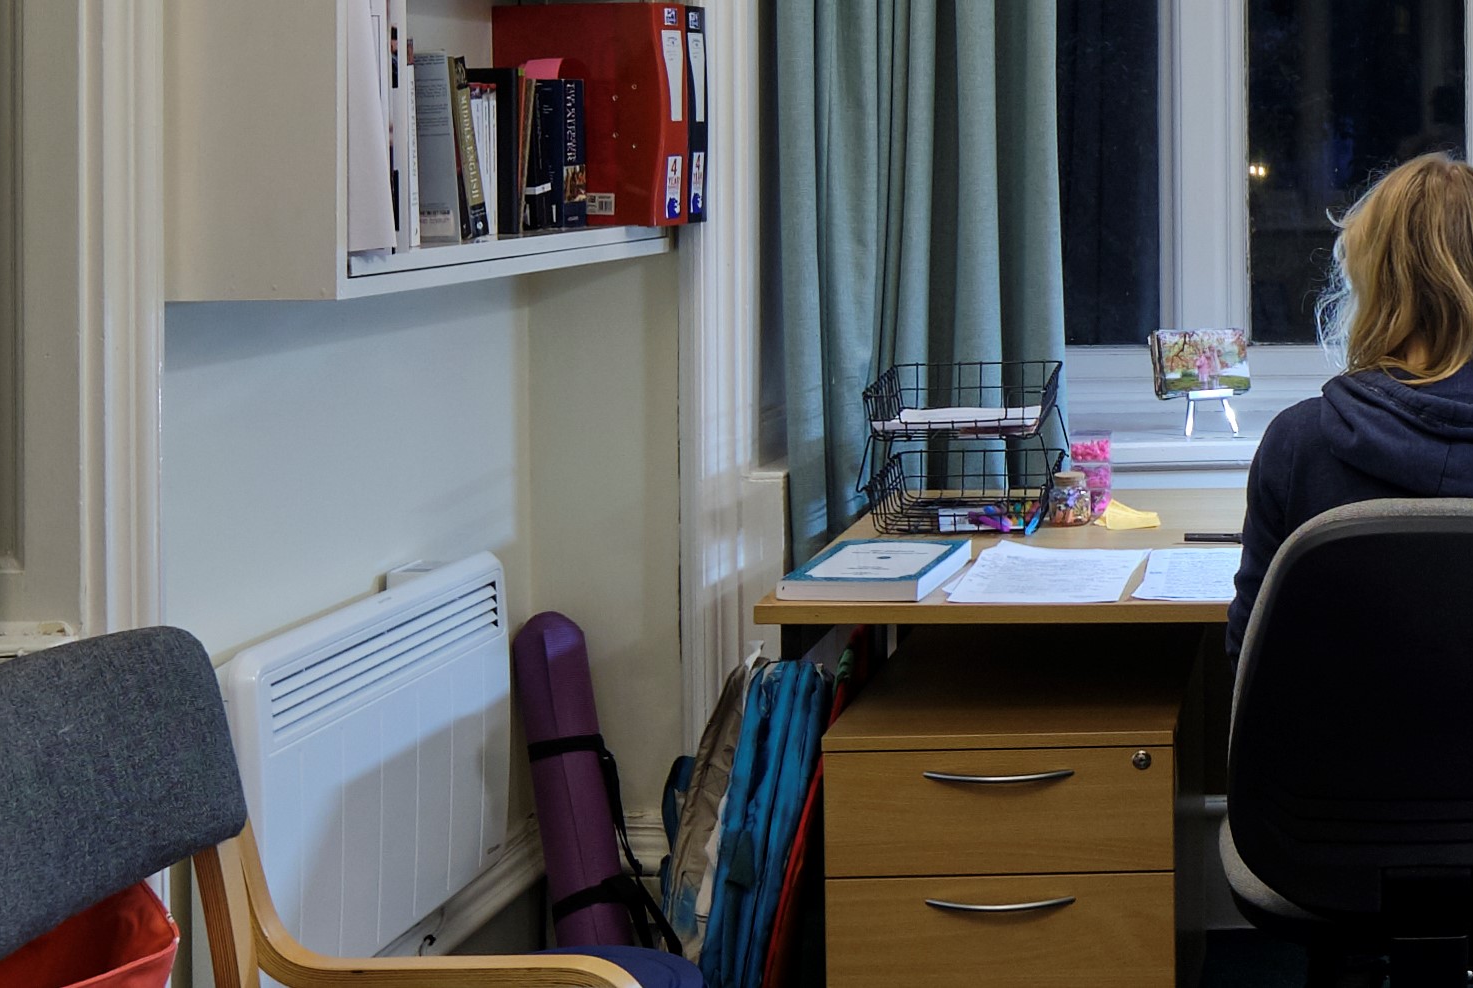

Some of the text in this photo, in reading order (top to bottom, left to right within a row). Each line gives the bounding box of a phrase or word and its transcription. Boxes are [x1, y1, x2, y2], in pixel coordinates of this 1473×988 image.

[457, 95, 472, 142] MIDDLE
[464, 145, 480, 198] ENGLISH
[671, 159, 677, 175] 4
[696, 154, 700, 170] 4
